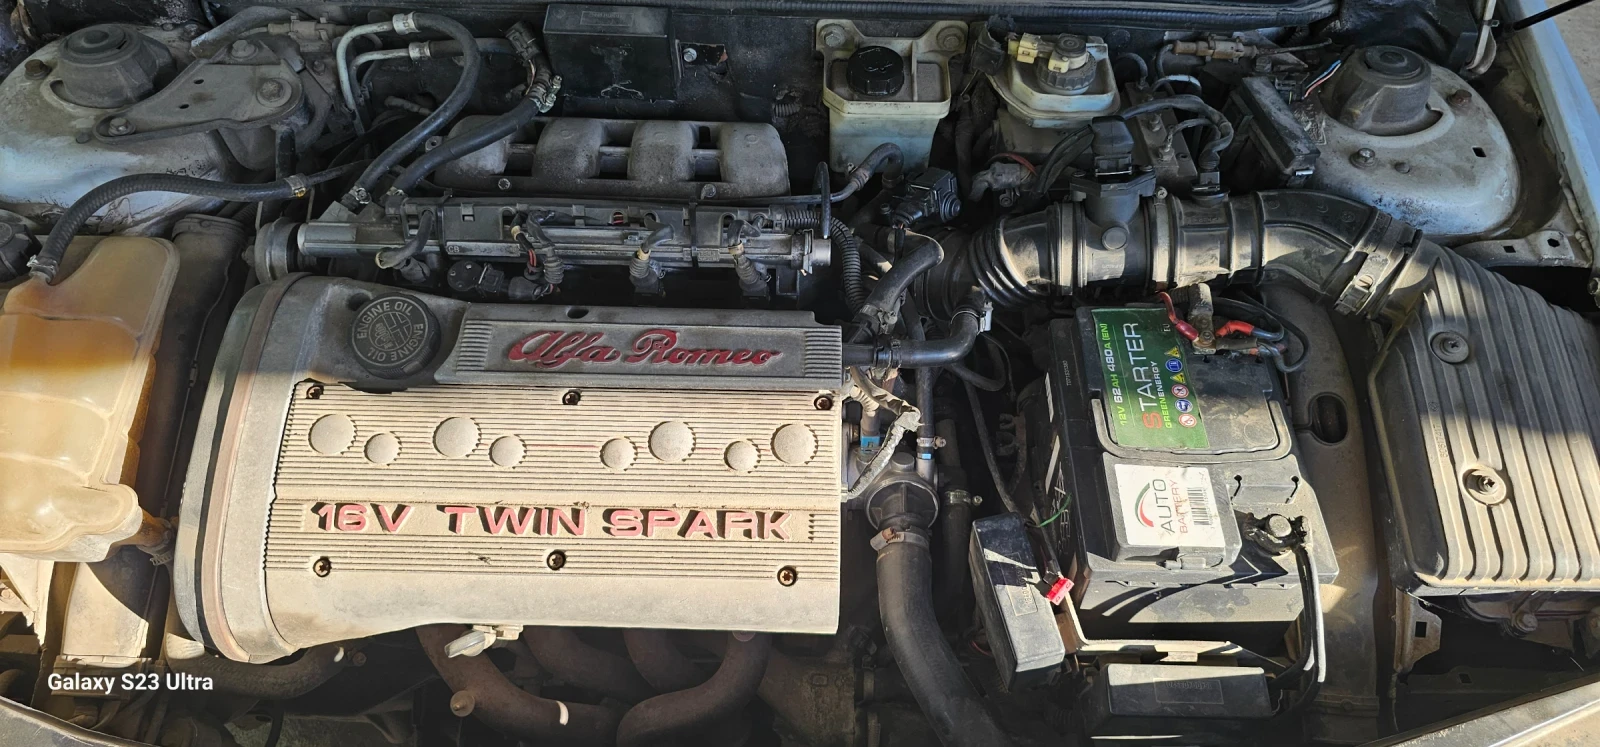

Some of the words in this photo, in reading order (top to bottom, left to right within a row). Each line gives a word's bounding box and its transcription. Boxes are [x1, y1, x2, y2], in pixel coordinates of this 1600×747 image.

[357, 301, 391, 339] ENGINE
[394, 301, 413, 316] OIL
[367, 347, 386, 361] OIL
[390, 323, 424, 360] ENGINE
[508, 330, 622, 369] Alfa
[624, 328, 783, 367] Romeo
[1104, 342, 1116, 372] 480A
[1110, 374, 1123, 403] 62AH
[1123, 323, 1163, 429] STARTER
[1117, 406, 1127, 426] 12V
[313, 503, 413, 533] 16V
[440, 506, 586, 536] TWIN
[605, 508, 791, 540] SPARK
[1152, 479, 1175, 534] AUTO
[1169, 479, 1188, 534] BATTERY
